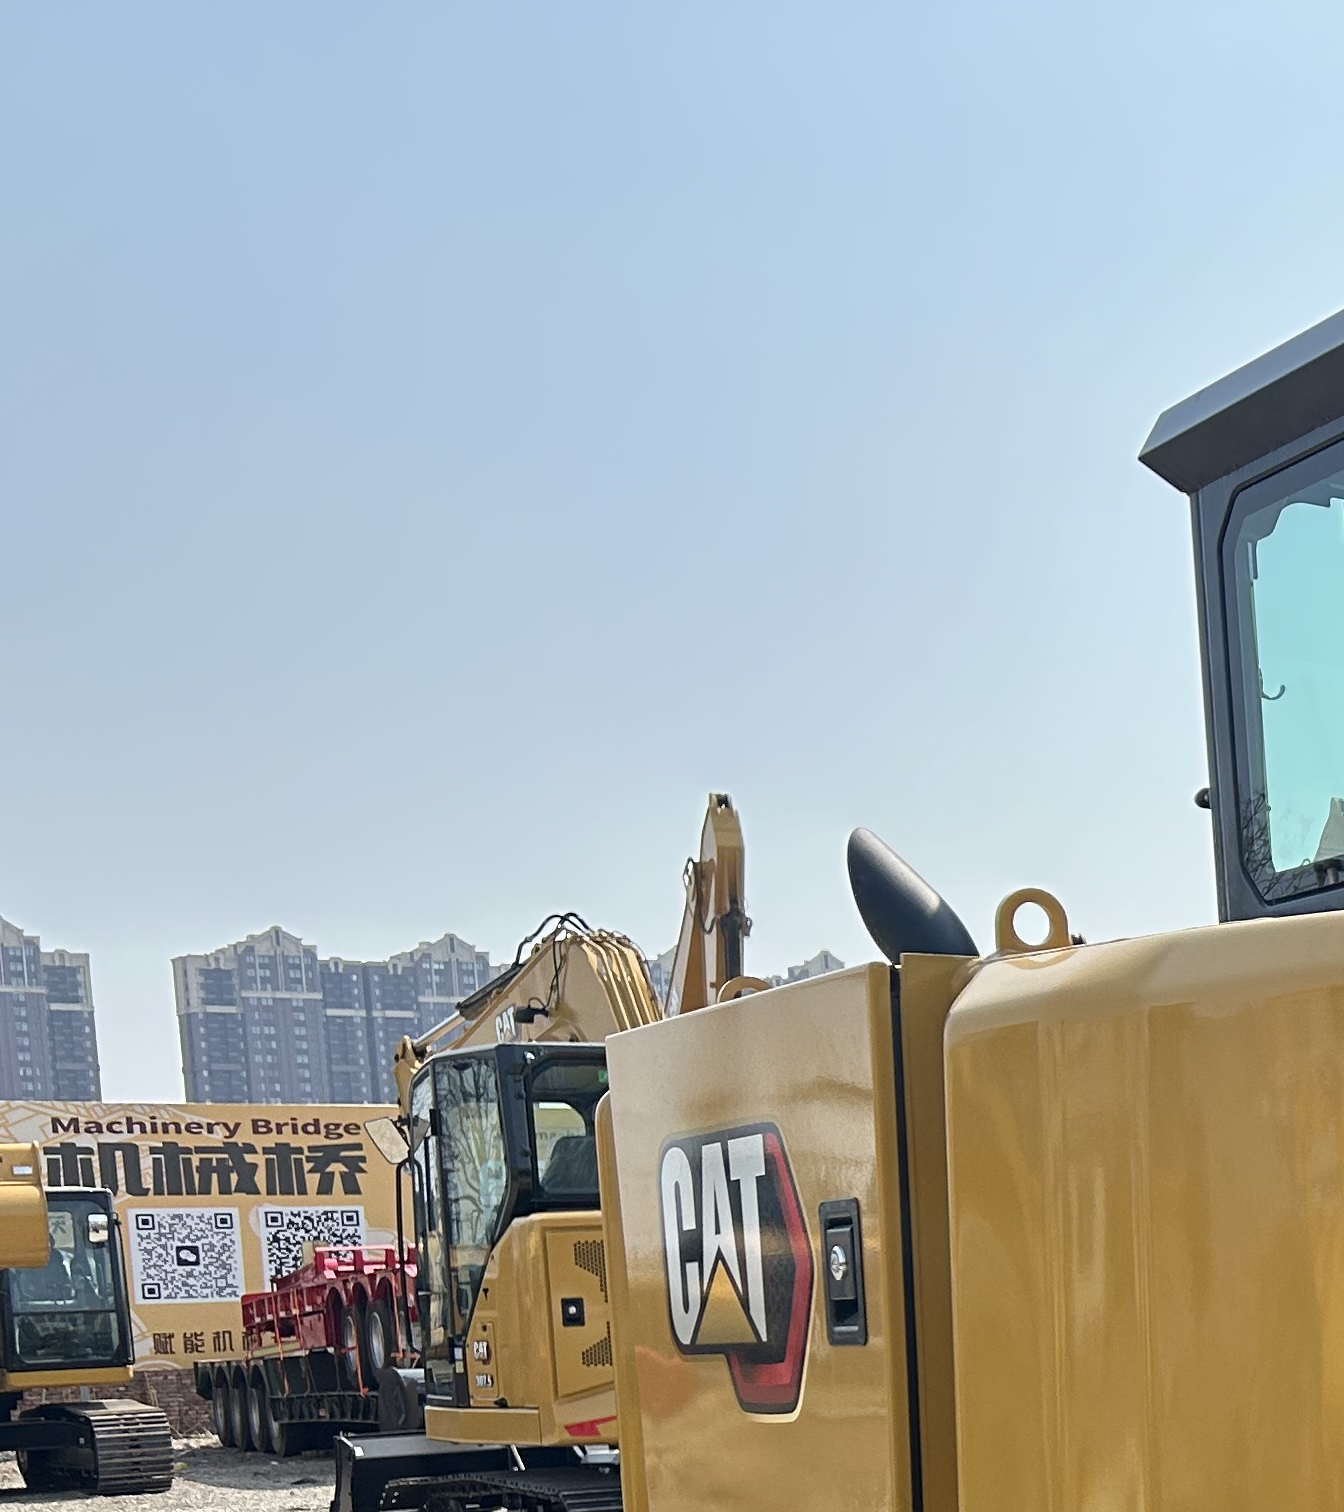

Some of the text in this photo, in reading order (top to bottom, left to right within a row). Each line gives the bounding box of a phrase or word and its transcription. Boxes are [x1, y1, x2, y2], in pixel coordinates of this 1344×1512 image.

[51, 1117, 361, 1140] Machinery Bridge
[43, 1142, 368, 1196] 机械桥
[661, 1134, 767, 1345] CAT
